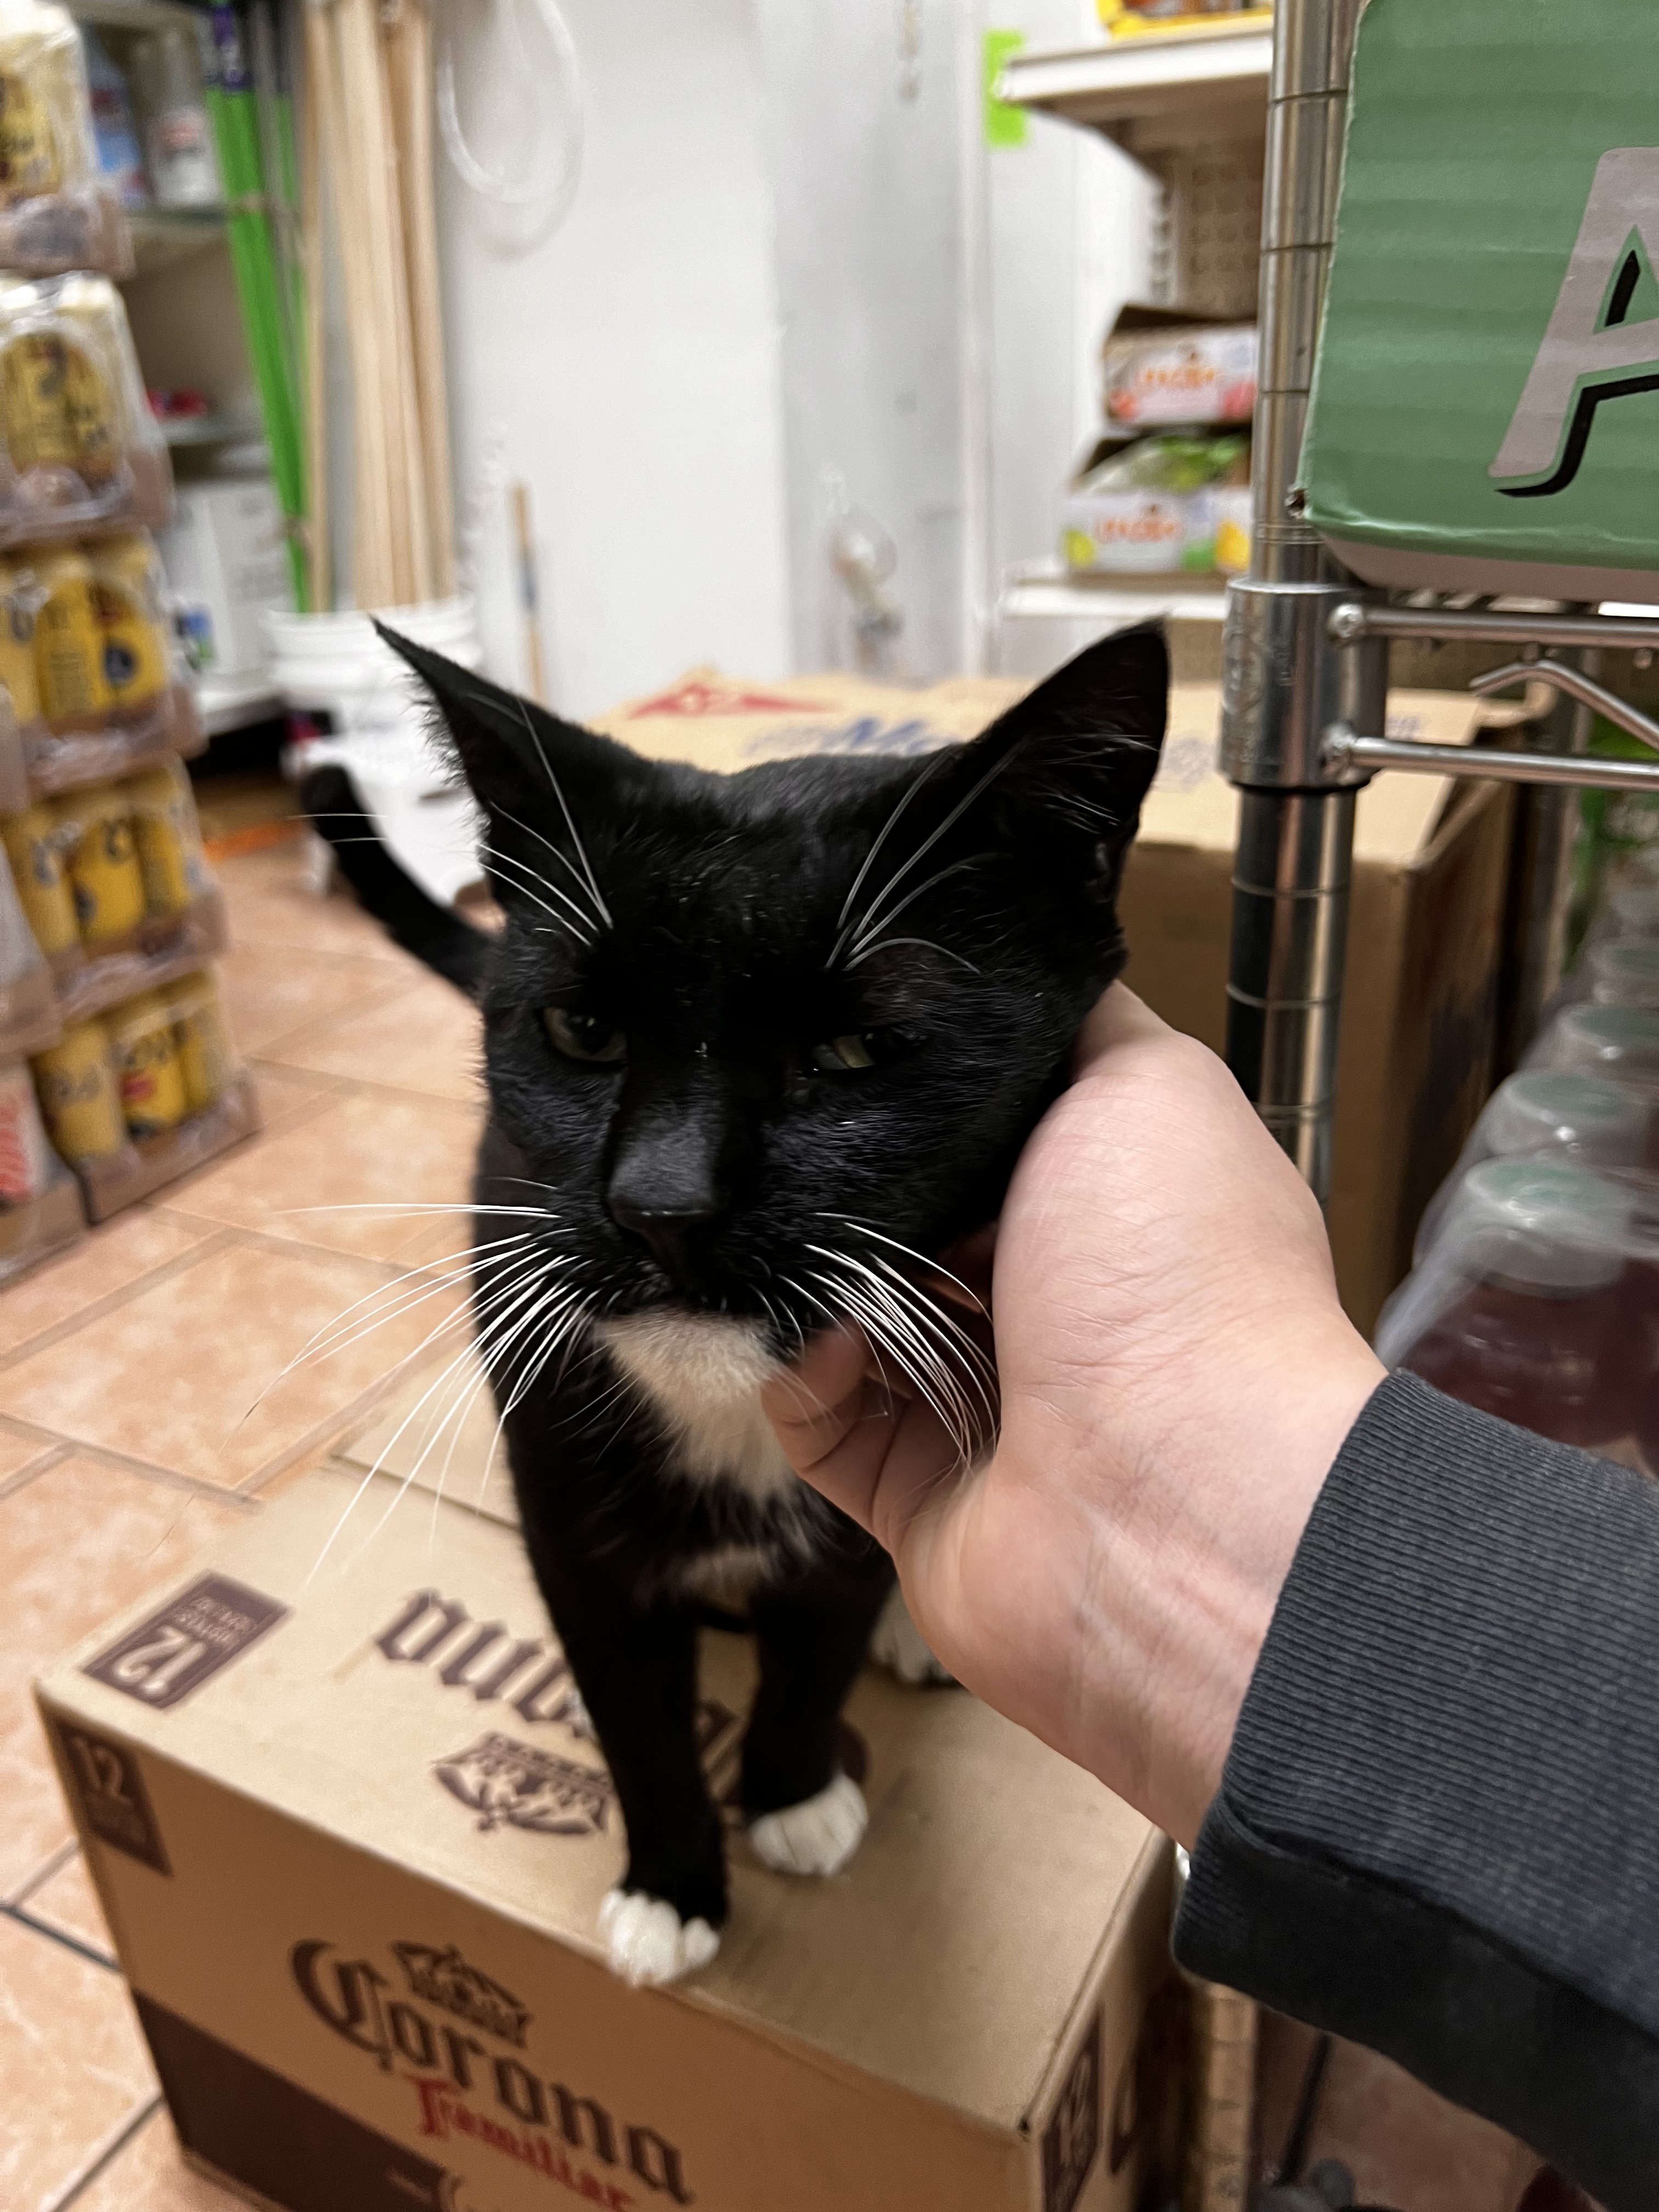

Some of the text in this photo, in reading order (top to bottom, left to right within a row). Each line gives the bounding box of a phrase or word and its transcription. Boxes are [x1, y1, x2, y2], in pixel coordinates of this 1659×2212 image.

[113, 1625, 207, 1697] 12
[71, 1735, 134, 1805] 12
[288, 1938, 696, 2205] Corona
